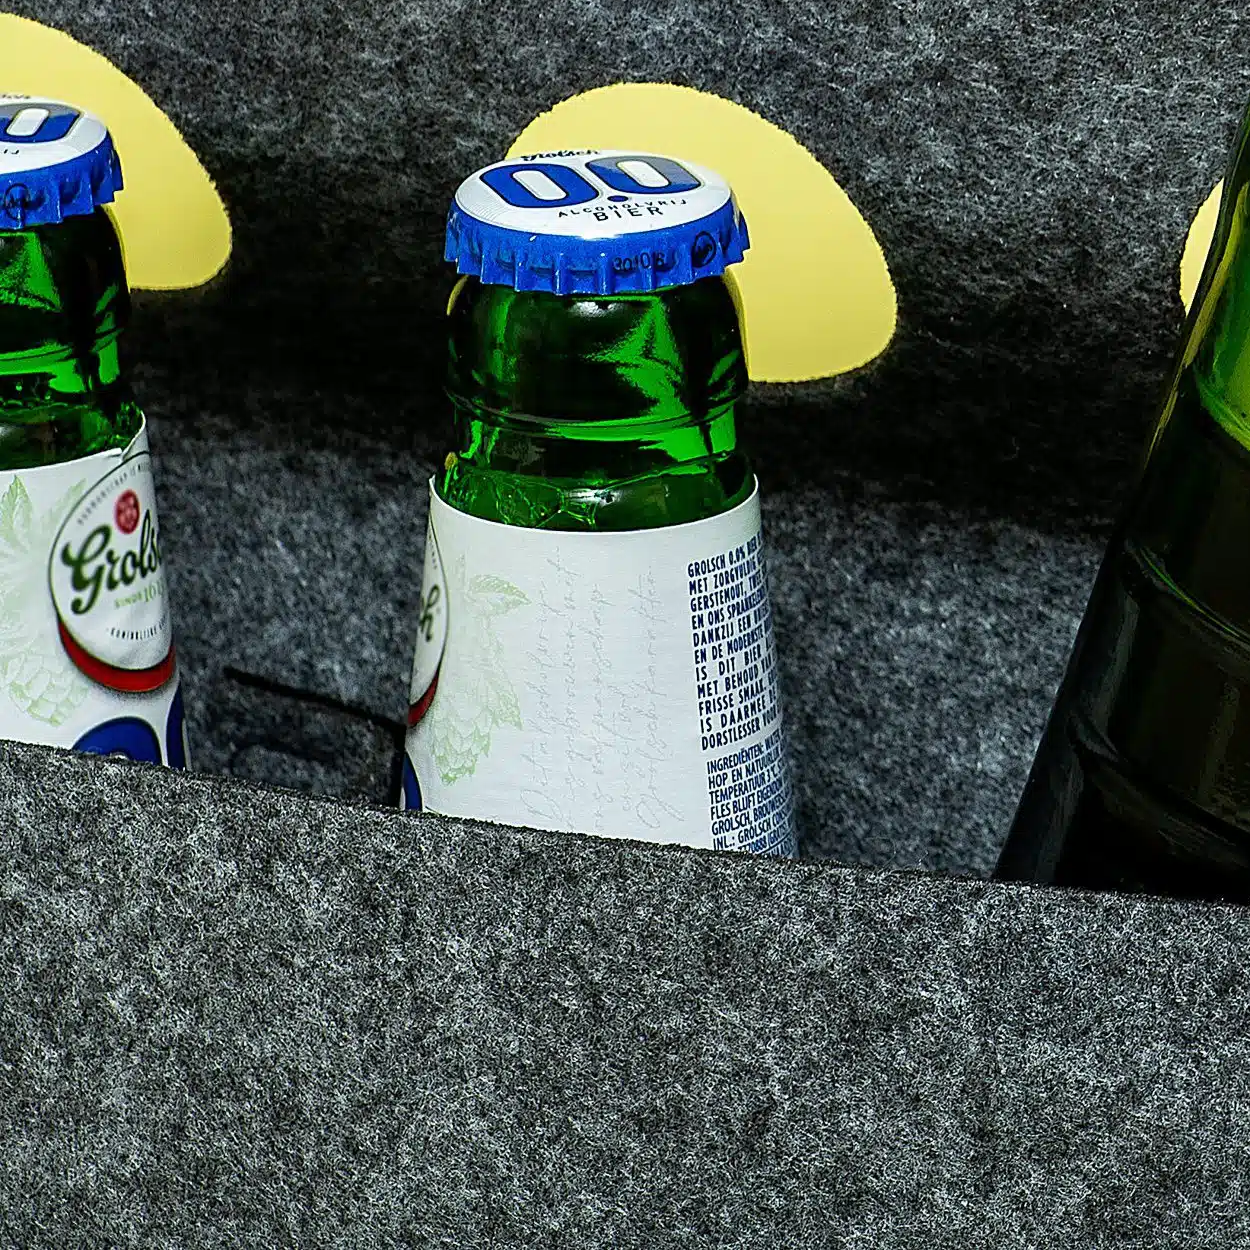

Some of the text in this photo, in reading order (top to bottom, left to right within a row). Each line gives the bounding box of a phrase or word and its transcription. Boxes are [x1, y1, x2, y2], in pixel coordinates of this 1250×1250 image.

[558, 199, 688, 218] ALCOHOLVRIJ
[593, 207, 664, 222] BIER
[687, 553, 726, 578] GROLSCH
[689, 577, 708, 595] MET
[691, 613, 704, 630] EN
[708, 607, 725, 626] ONS
[693, 622, 734, 647] DANKZIJ
[738, 614, 751, 633] EEN
[694, 647, 707, 664] EN
[711, 643, 723, 660] DE
[696, 666, 707, 682] IS
[718, 657, 735, 676] DIT
[744, 643, 762, 666] BIER
[697, 680, 718, 699] MET
[724, 664, 759, 692] BEHOUD
[699, 678, 767, 717] FRISSE SMAAK.
[700, 717, 712, 734] IS
[720, 694, 766, 728] DAARMEE
[701, 716, 761, 751] DORSTLESSER
[708, 772, 728, 790] HOP
[731, 767, 743, 783] EN
[709, 772, 766, 805] TEMPERATUUR
[710, 802, 731, 821] FLES
[737, 817, 772, 843] GROLSCH
